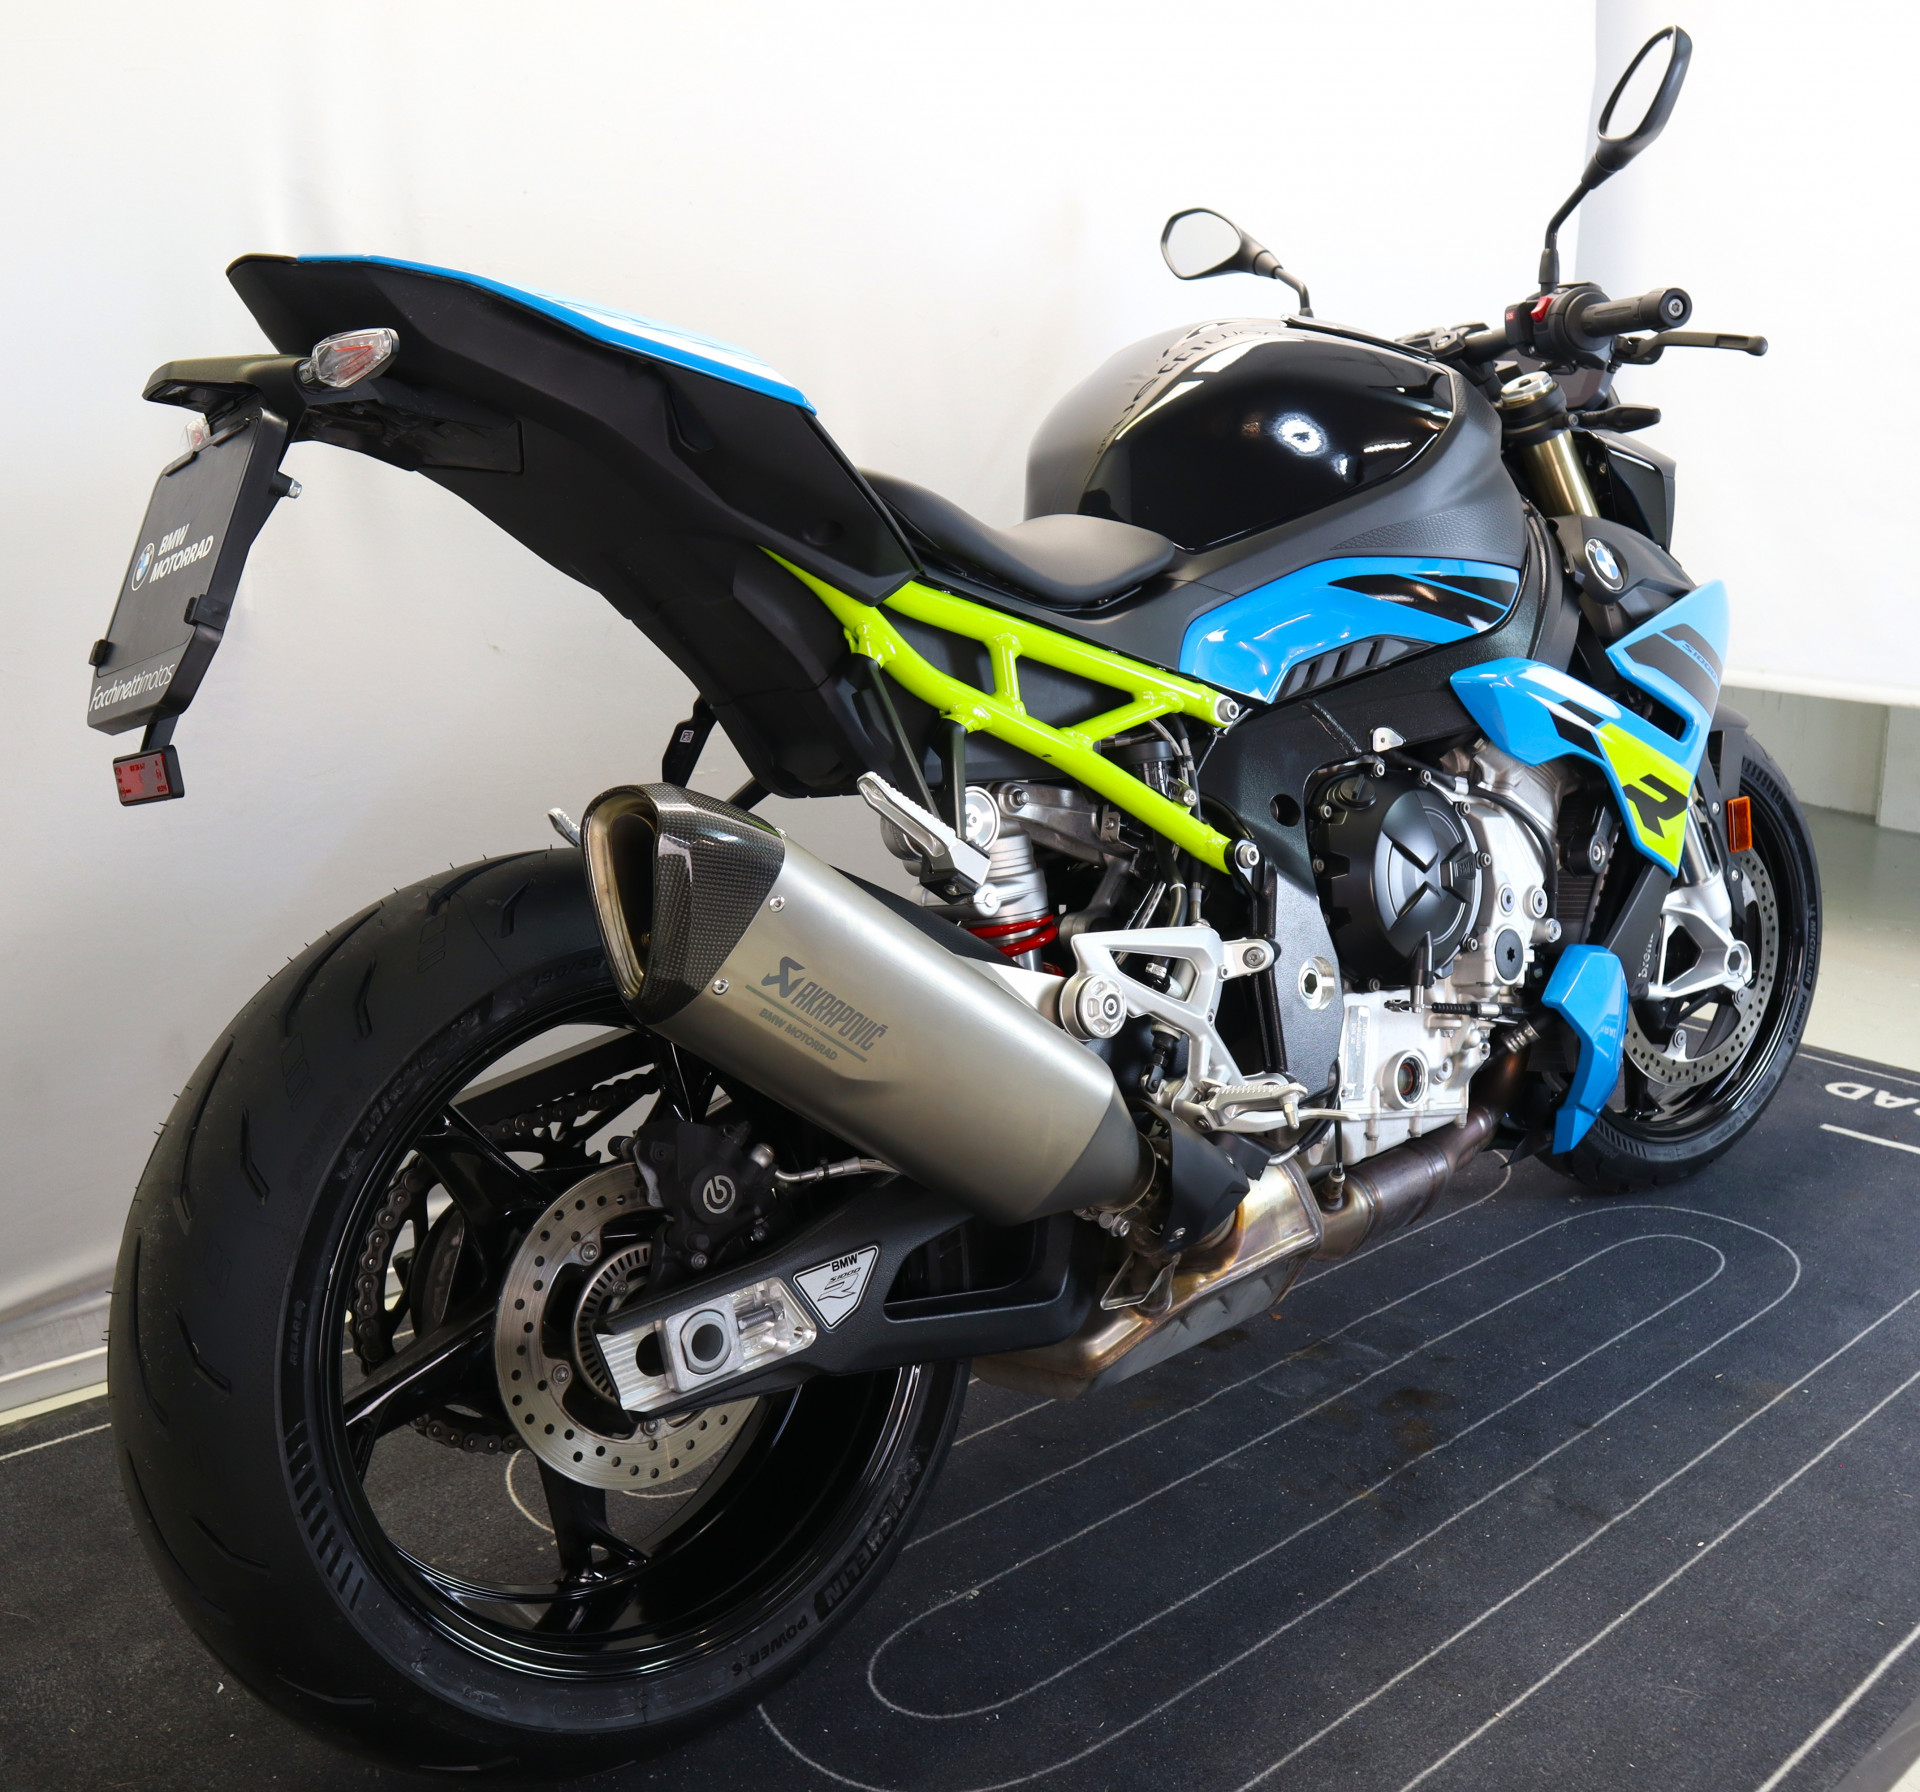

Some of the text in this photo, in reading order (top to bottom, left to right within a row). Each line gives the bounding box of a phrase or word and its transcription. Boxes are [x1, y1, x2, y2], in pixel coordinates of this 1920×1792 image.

[149, 535, 214, 583] MOTORRAD
[158, 523, 190, 557] BMW
[758, 1007, 787, 1029] BMW
[784, 1023, 839, 1061] MOTORRAD
[1825, 1081, 1920, 1117] AD
[831, 1253, 858, 1272] BMW
[748, 1614, 808, 1667] POWER
